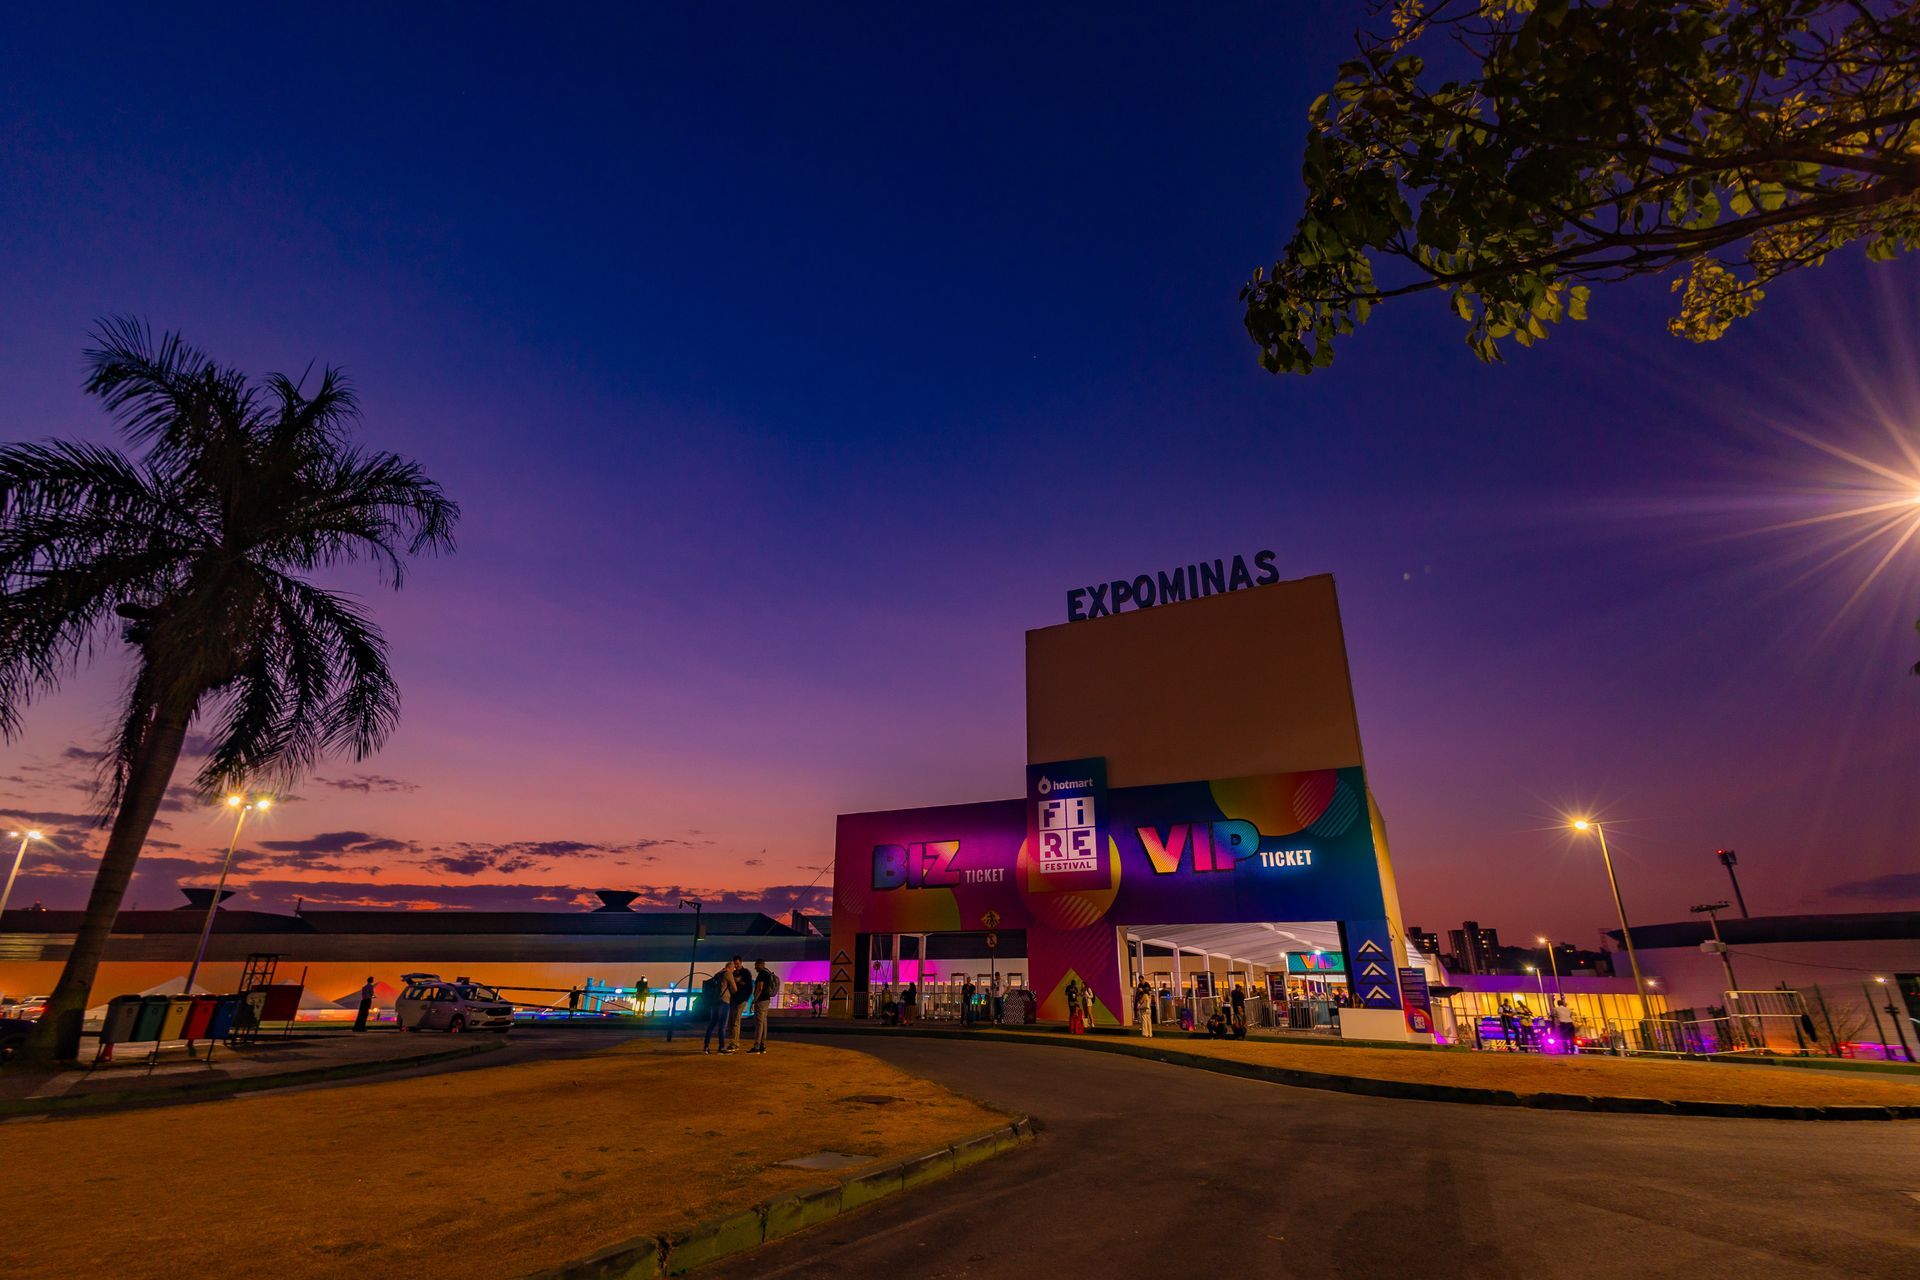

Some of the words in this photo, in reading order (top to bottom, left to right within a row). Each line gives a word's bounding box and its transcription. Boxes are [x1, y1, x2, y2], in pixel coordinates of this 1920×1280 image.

[1066, 550, 1280, 622] EXPOMINAS
[1053, 778, 1094, 790] hotmart
[1136, 819, 1261, 875] VIP
[1260, 850, 1312, 867] TICKET
[872, 840, 960, 890] BIZ
[965, 868, 1005, 883] TICKET
[1045, 862, 1092, 871] FESTIVAL
[1300, 954, 1340, 969] VIP
